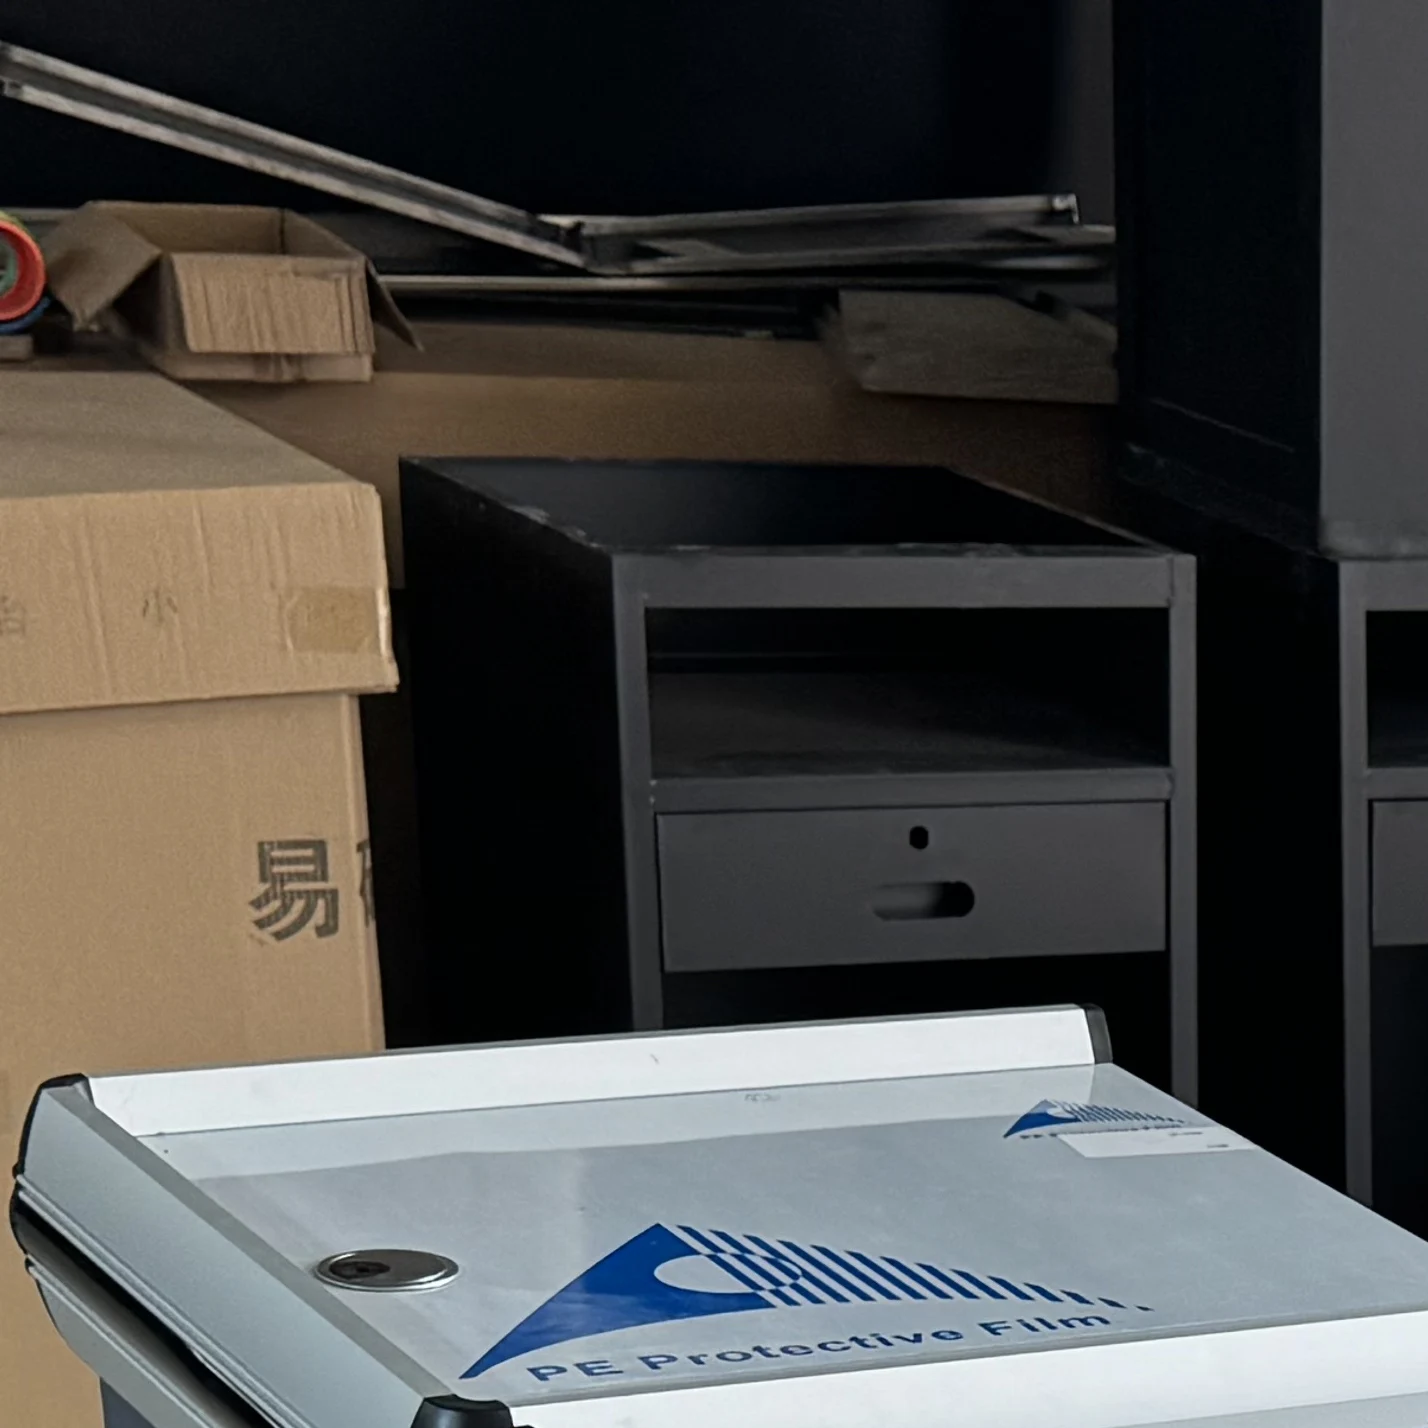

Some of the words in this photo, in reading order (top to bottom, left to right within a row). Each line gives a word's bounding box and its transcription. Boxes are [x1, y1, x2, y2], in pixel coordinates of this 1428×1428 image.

[249, 837, 376, 942] 易
[527, 1359, 624, 1382] PE
[636, 1329, 964, 1371] Protective
[978, 1310, 1112, 1337] Film
